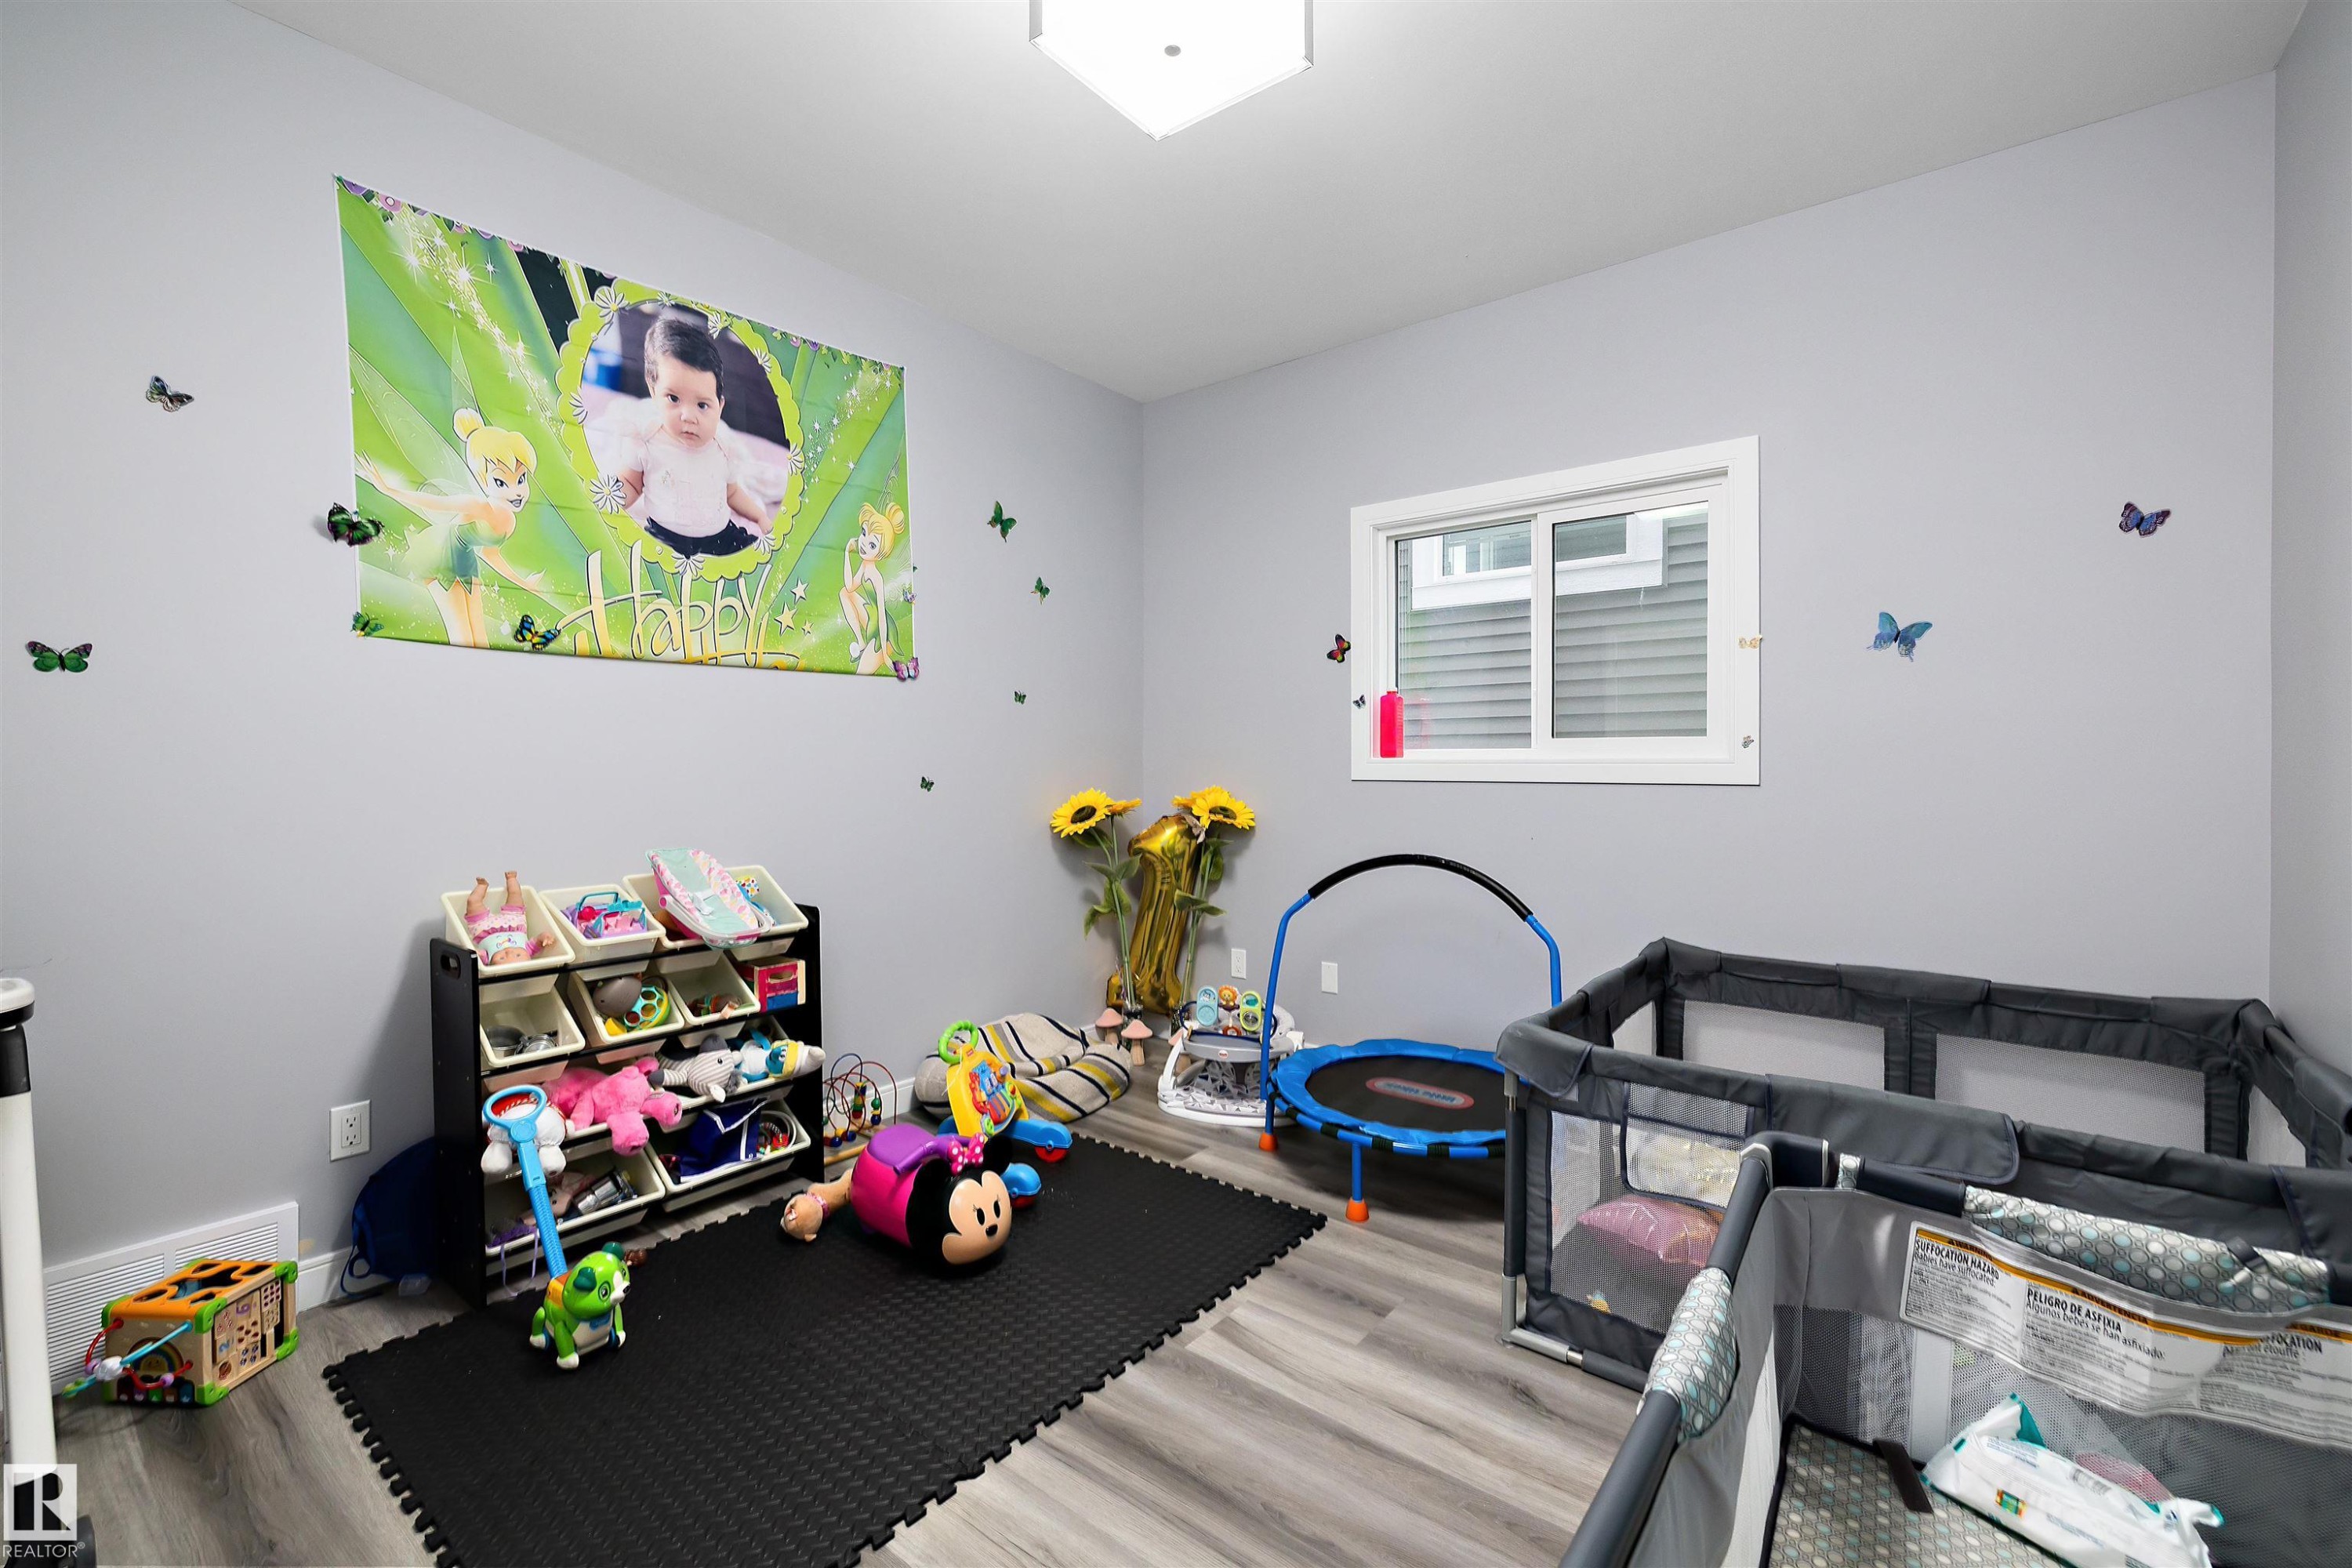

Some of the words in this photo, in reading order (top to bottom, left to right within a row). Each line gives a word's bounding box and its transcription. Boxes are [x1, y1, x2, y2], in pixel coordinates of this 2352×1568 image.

[556, 539, 771, 665] Happy
[1915, 1238, 1969, 1266] SUFFOCATION
[1970, 1257, 1999, 1280] HAZARD
[1939, 1258, 1958, 1272] have
[1958, 1263, 1996, 1288] suffocated:
[2026, 1298, 2062, 1321] Algunos
[2091, 1323, 2101, 1334] se
[2103, 1324, 2120, 1342] han
[2122, 1334, 2165, 1360] asfixiado:
[2027, 1287, 2068, 1313] PELIGRO
[2070, 1303, 2082, 1317] DE
[2085, 1307, 2122, 1334] ASFIXIA
